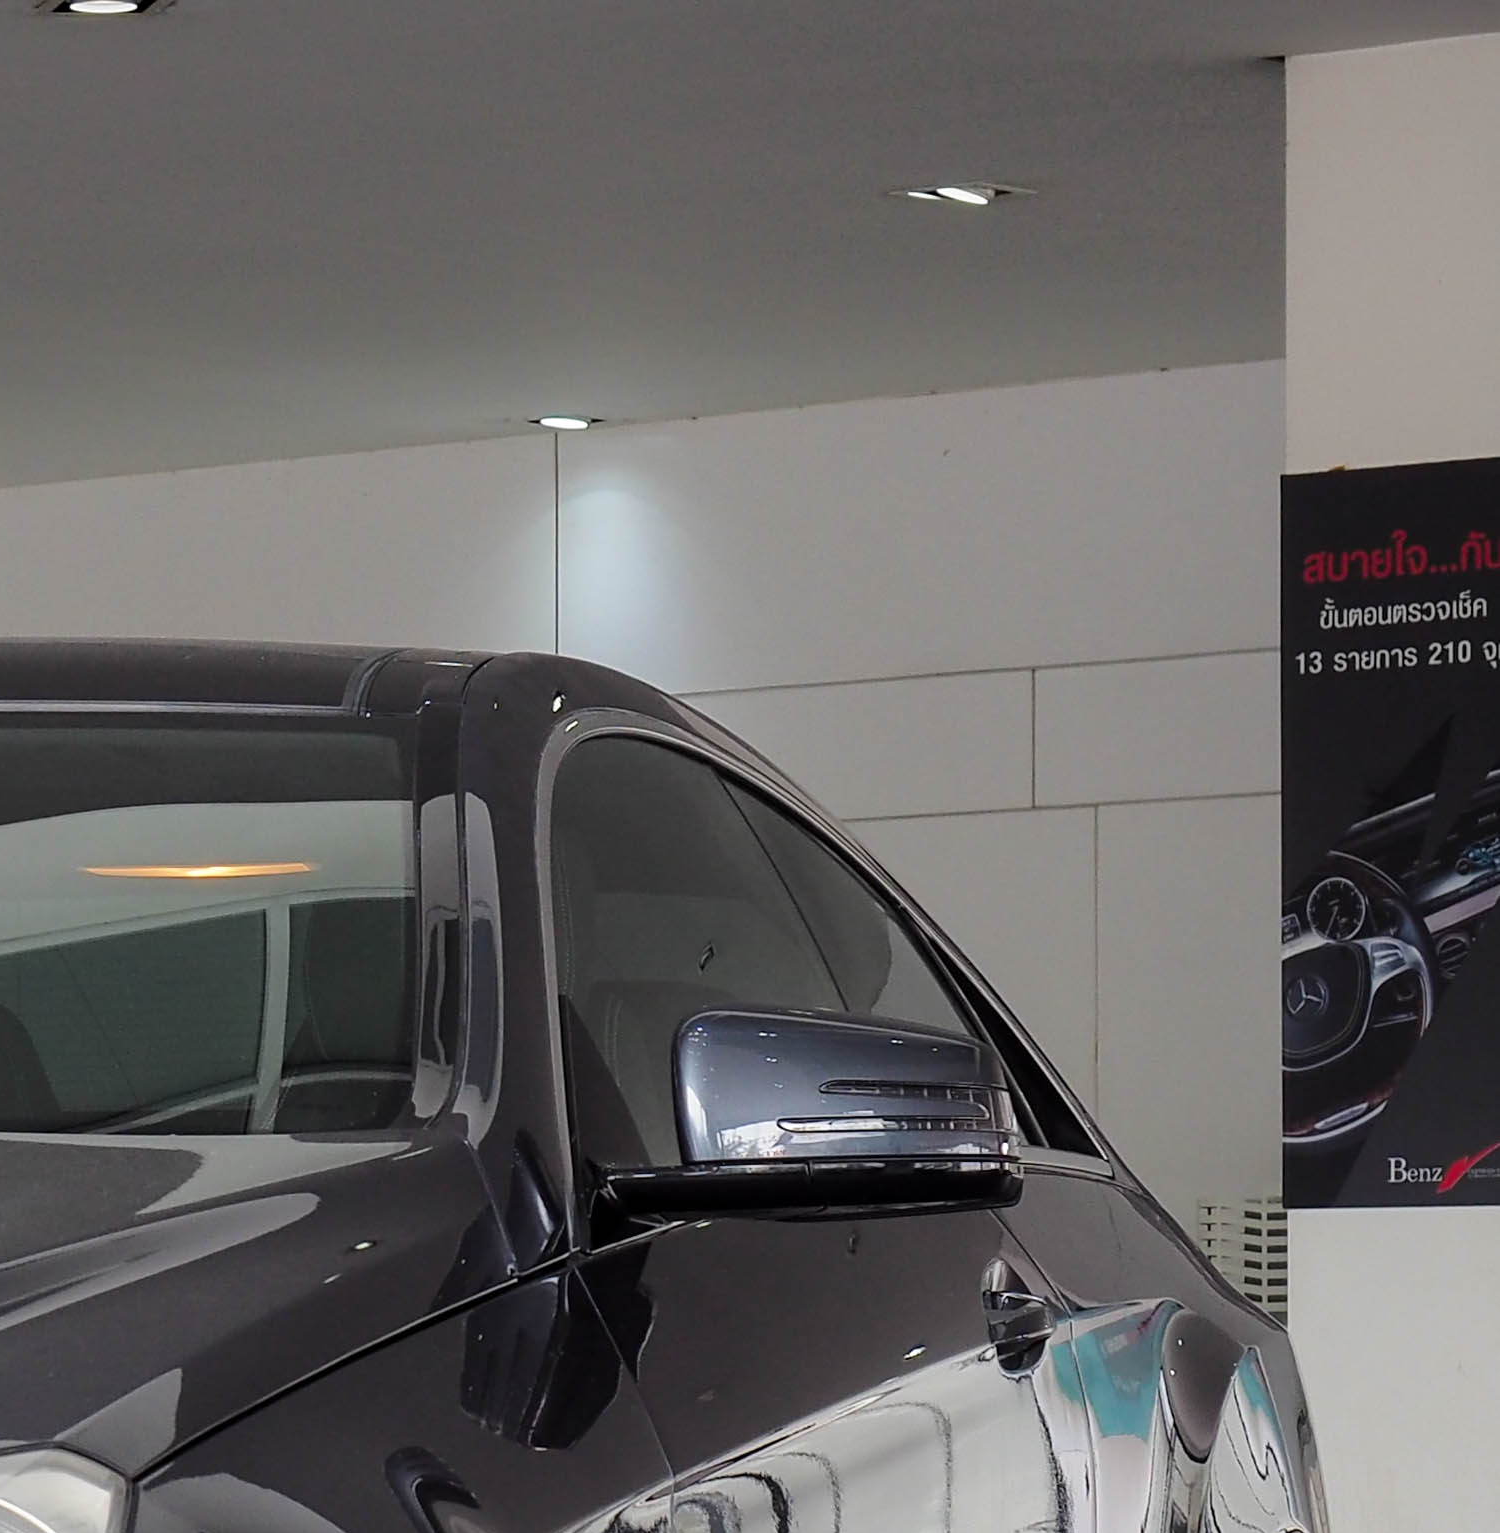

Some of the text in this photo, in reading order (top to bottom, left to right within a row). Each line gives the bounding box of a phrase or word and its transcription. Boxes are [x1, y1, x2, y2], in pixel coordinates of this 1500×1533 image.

[1319, 590, 1488, 630] ขั้นตอนตรวจเช็ค
[1295, 640, 1500, 675] 13 รายการ 210 จุ
[1388, 1157, 1443, 1183] Benz
